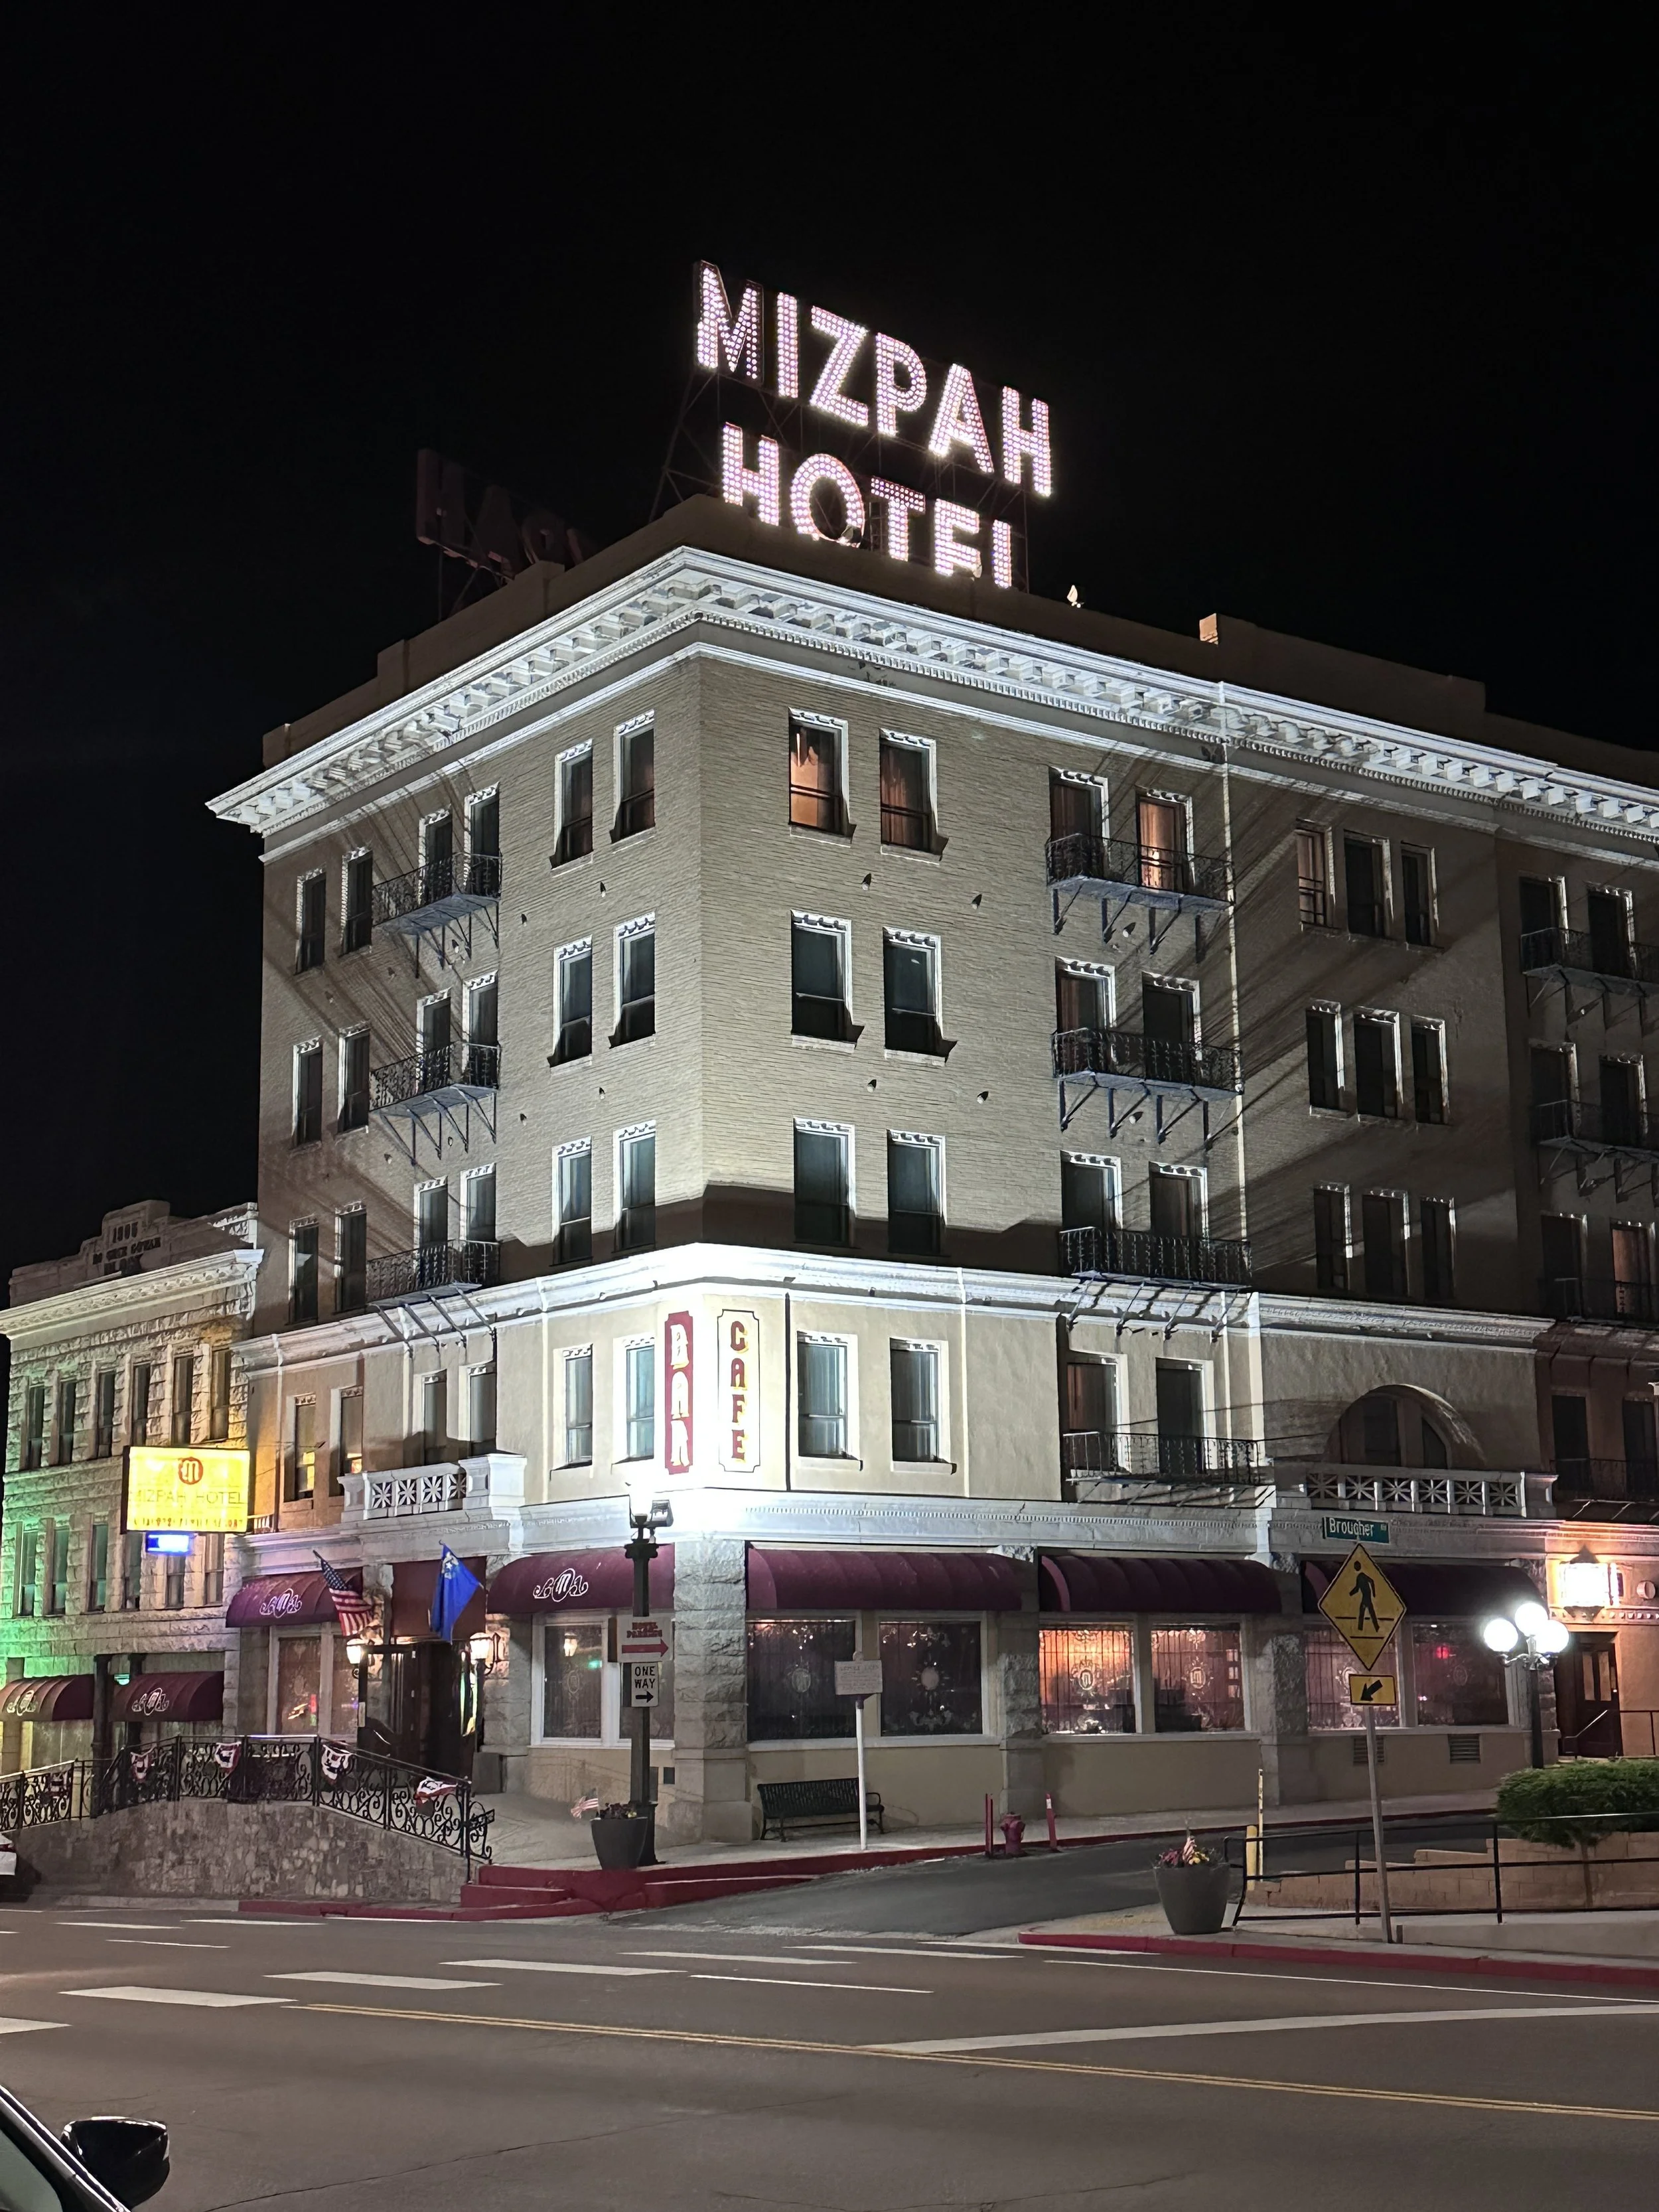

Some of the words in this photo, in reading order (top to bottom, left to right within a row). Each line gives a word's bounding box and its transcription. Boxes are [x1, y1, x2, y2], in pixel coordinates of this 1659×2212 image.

[695, 259, 1052, 498] MIZPAH
[670, 1323, 689, 1467] BAR
[730, 1320, 748, 1461] CAFE
[196, 1491, 243, 1505] HOTEL
[634, 1666, 656, 1676] ONE
[634, 1678, 656, 1689] WAY
